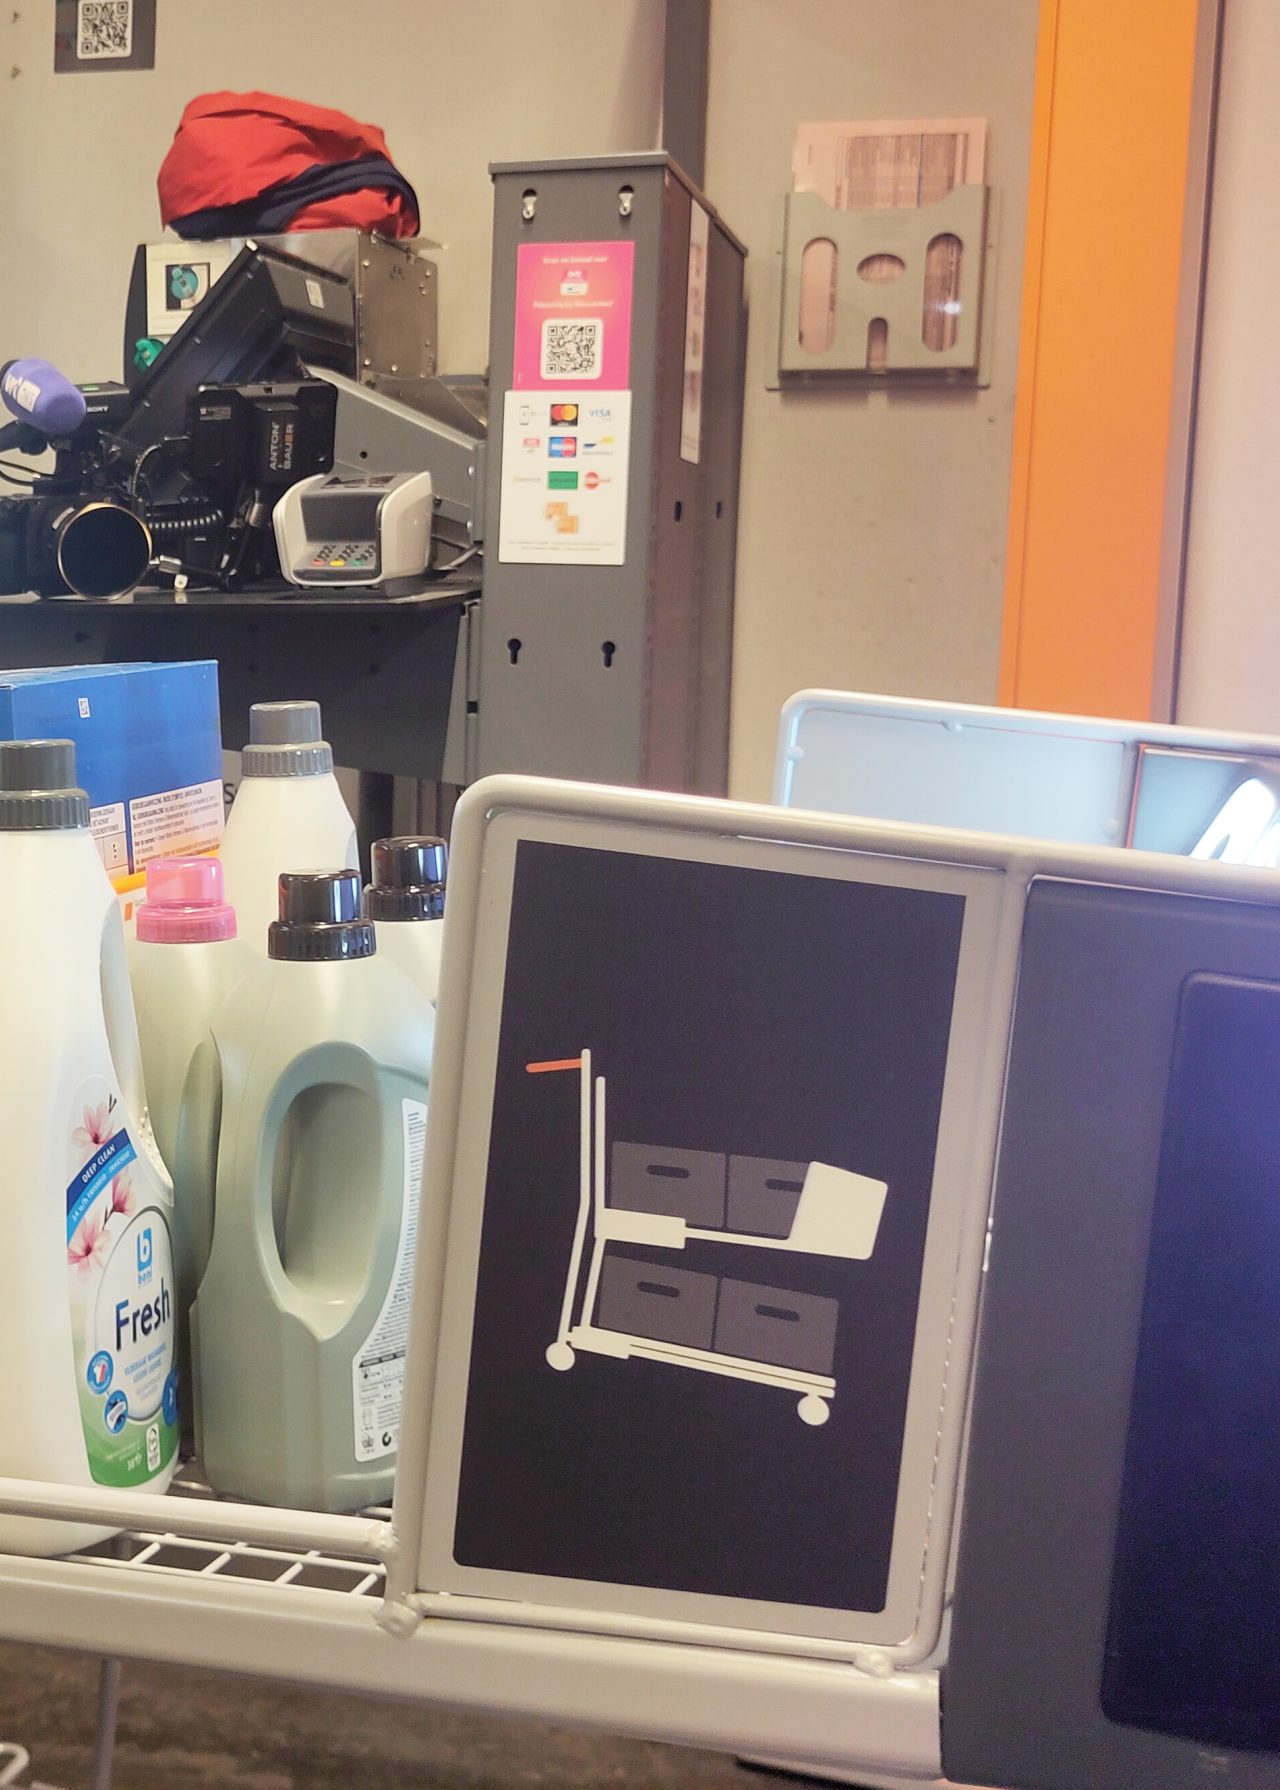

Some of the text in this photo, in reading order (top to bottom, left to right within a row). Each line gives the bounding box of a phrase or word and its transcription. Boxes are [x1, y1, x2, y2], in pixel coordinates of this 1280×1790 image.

[589, 409, 610, 418] VISA
[269, 423, 280, 471] ANTON
[81, 1144, 116, 1183] DEEP CLEAN
[116, 1277, 170, 1351] Fresh
